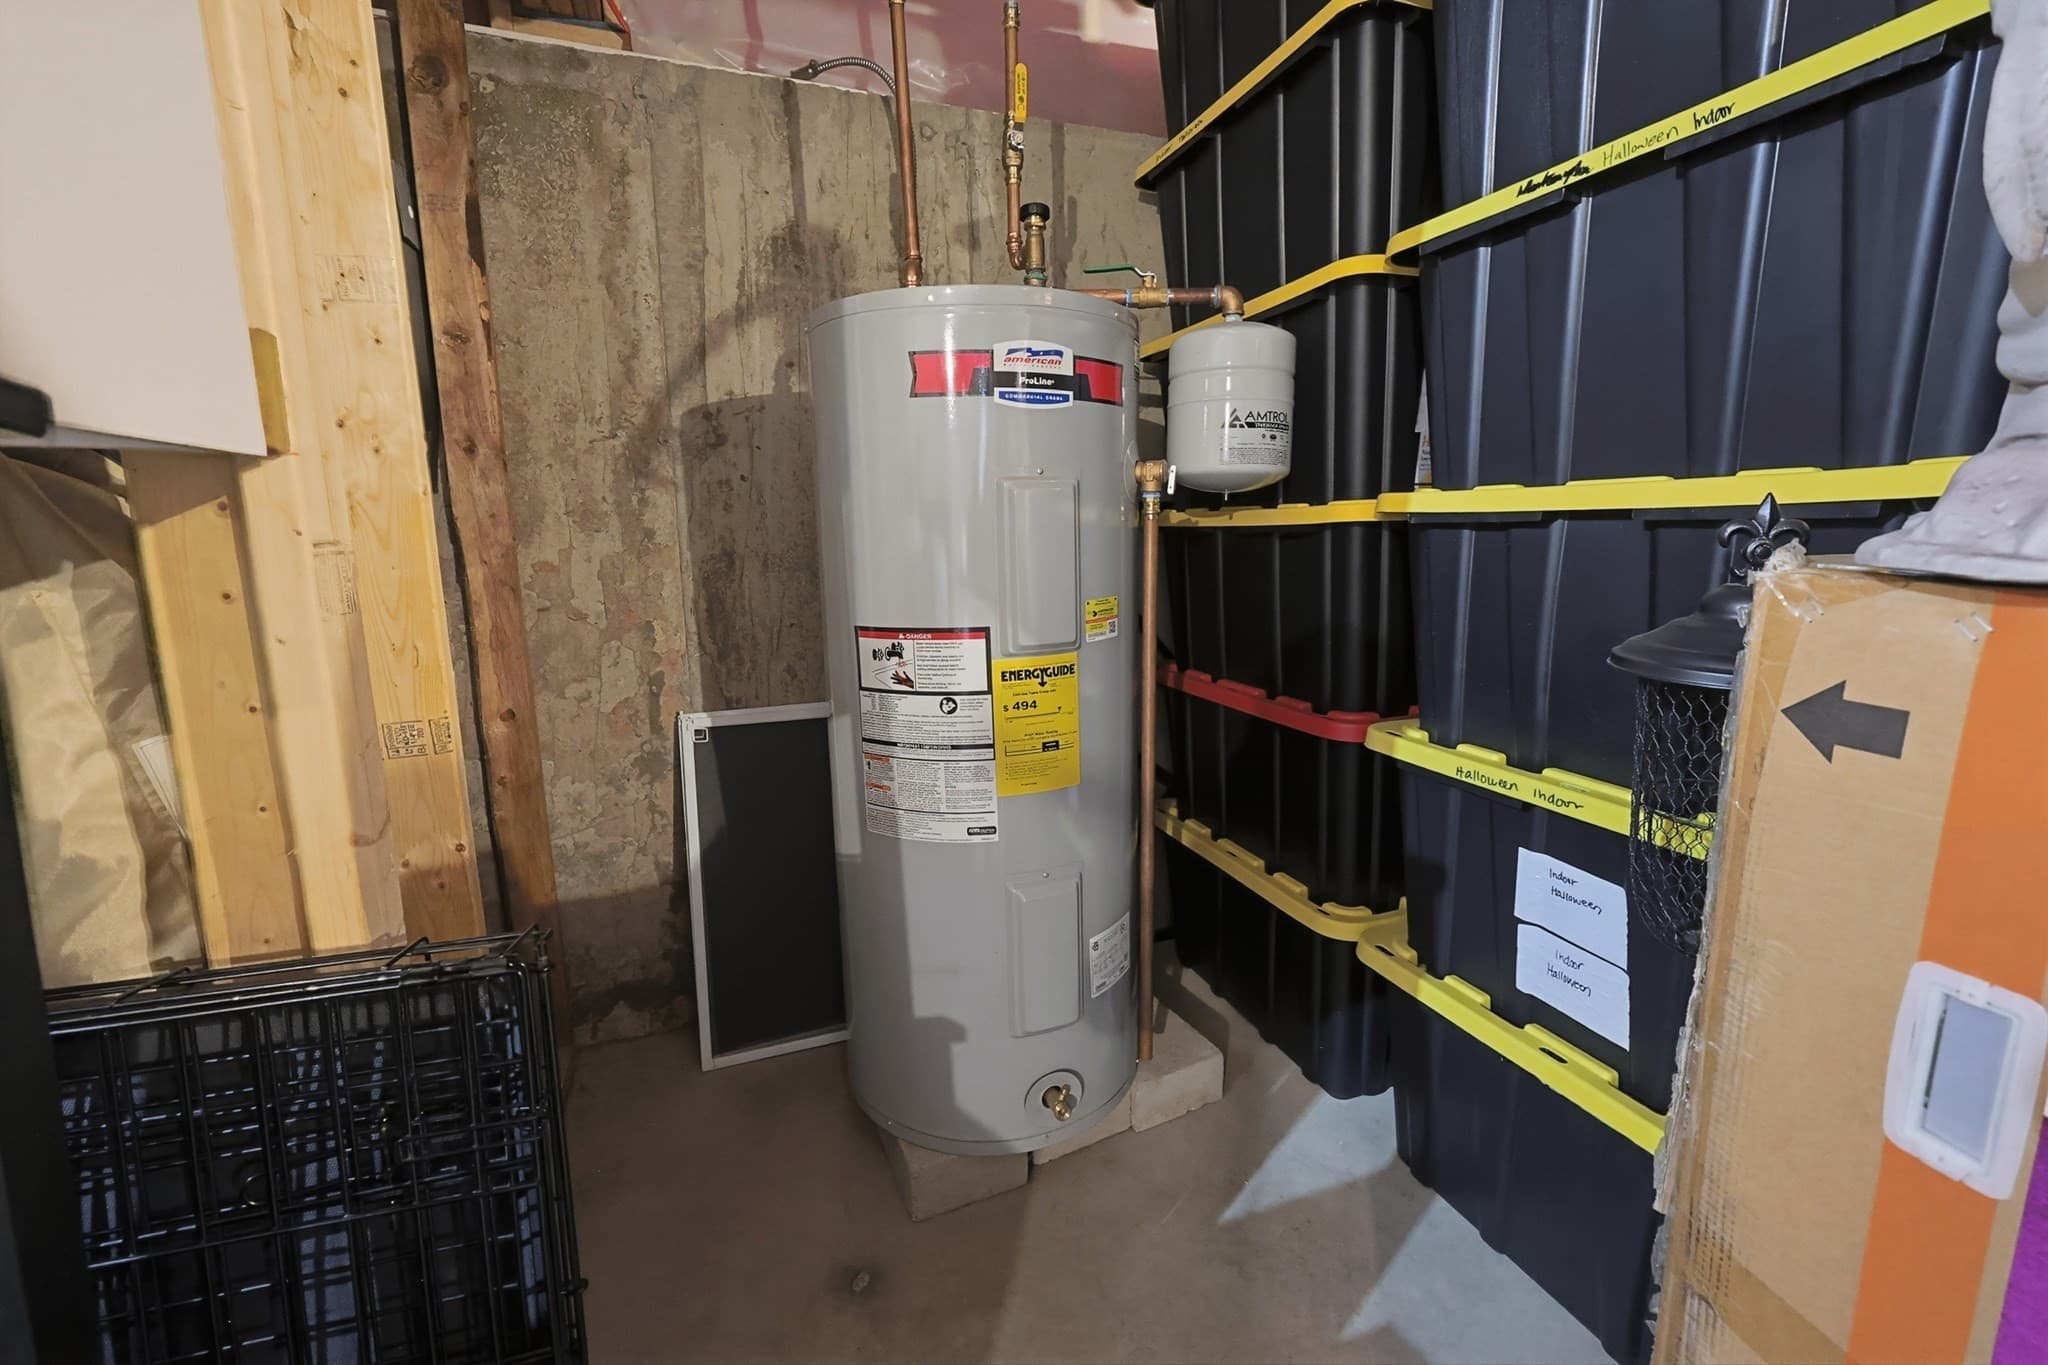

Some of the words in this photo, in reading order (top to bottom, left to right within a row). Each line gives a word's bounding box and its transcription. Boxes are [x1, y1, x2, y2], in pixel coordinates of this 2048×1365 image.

[1602, 126, 1679, 167] Halloween
[1693, 102, 1736, 131] Indoor
[1003, 356, 1062, 366] american
[1012, 700, 1038, 711] 494
[1456, 766, 1519, 792] Halloween
[1533, 788, 1584, 809] Indoor
[1549, 868, 1579, 886] Indoor
[1551, 885, 1602, 915] Halloween
[1555, 949, 1584, 970] Indoor
[1547, 963, 1592, 997] Halloween
